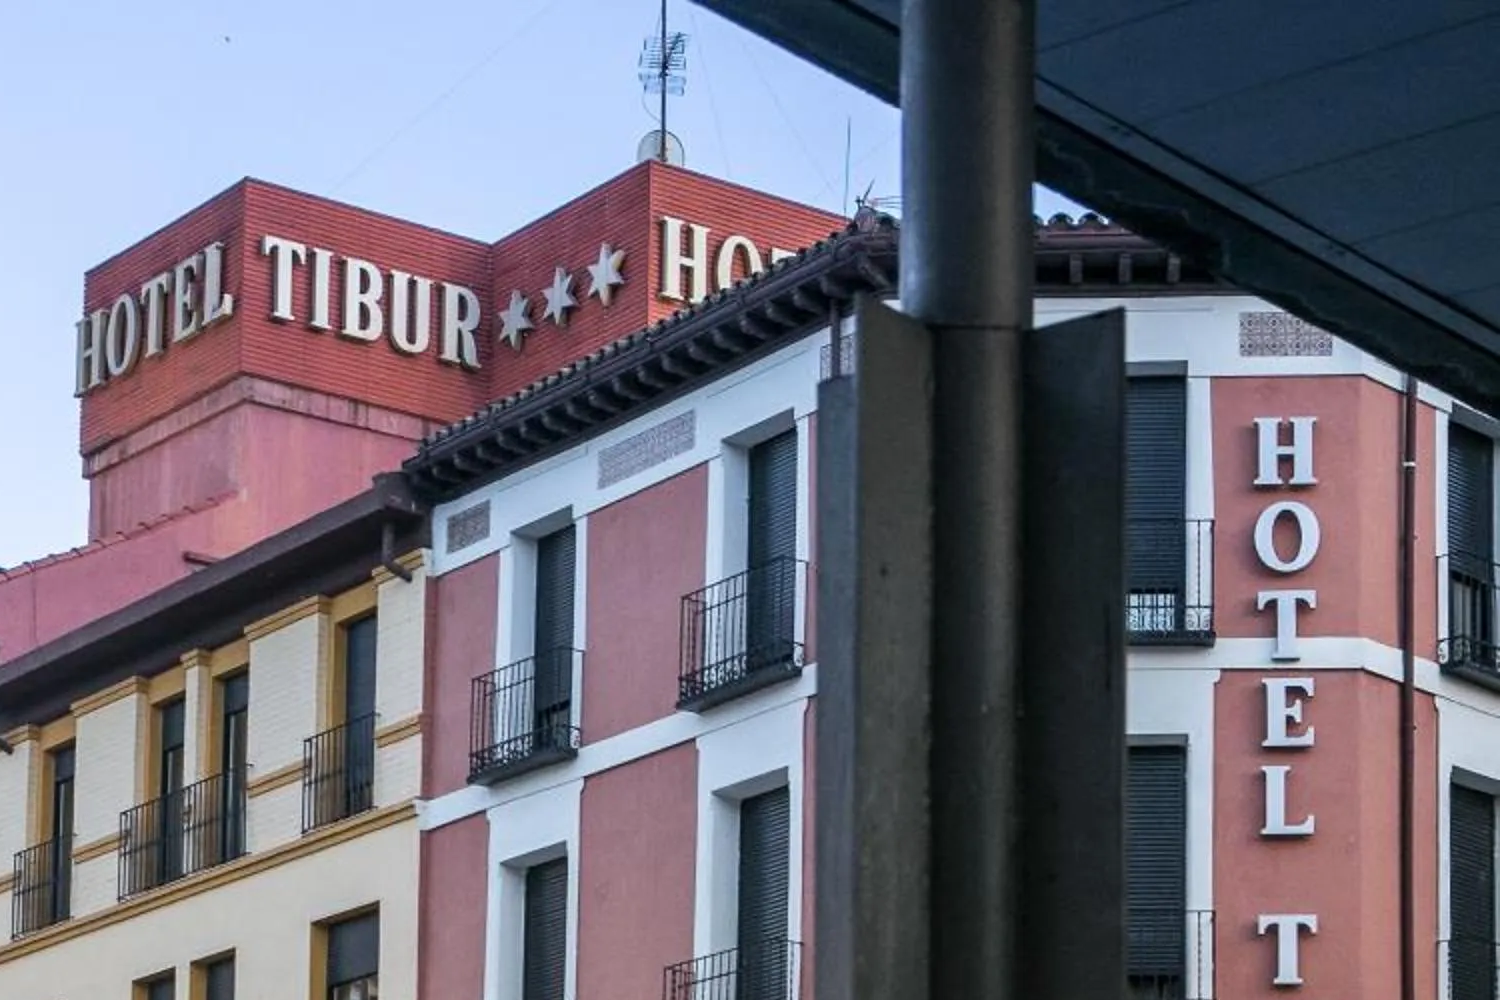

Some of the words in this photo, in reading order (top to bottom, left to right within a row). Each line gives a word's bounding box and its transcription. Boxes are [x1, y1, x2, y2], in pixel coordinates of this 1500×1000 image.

[74, 241, 233, 398] HOTEL
[261, 233, 482, 369] TIBUR
[660, 215, 799, 304] HO
[1253, 416, 1321, 836] HOTEL
